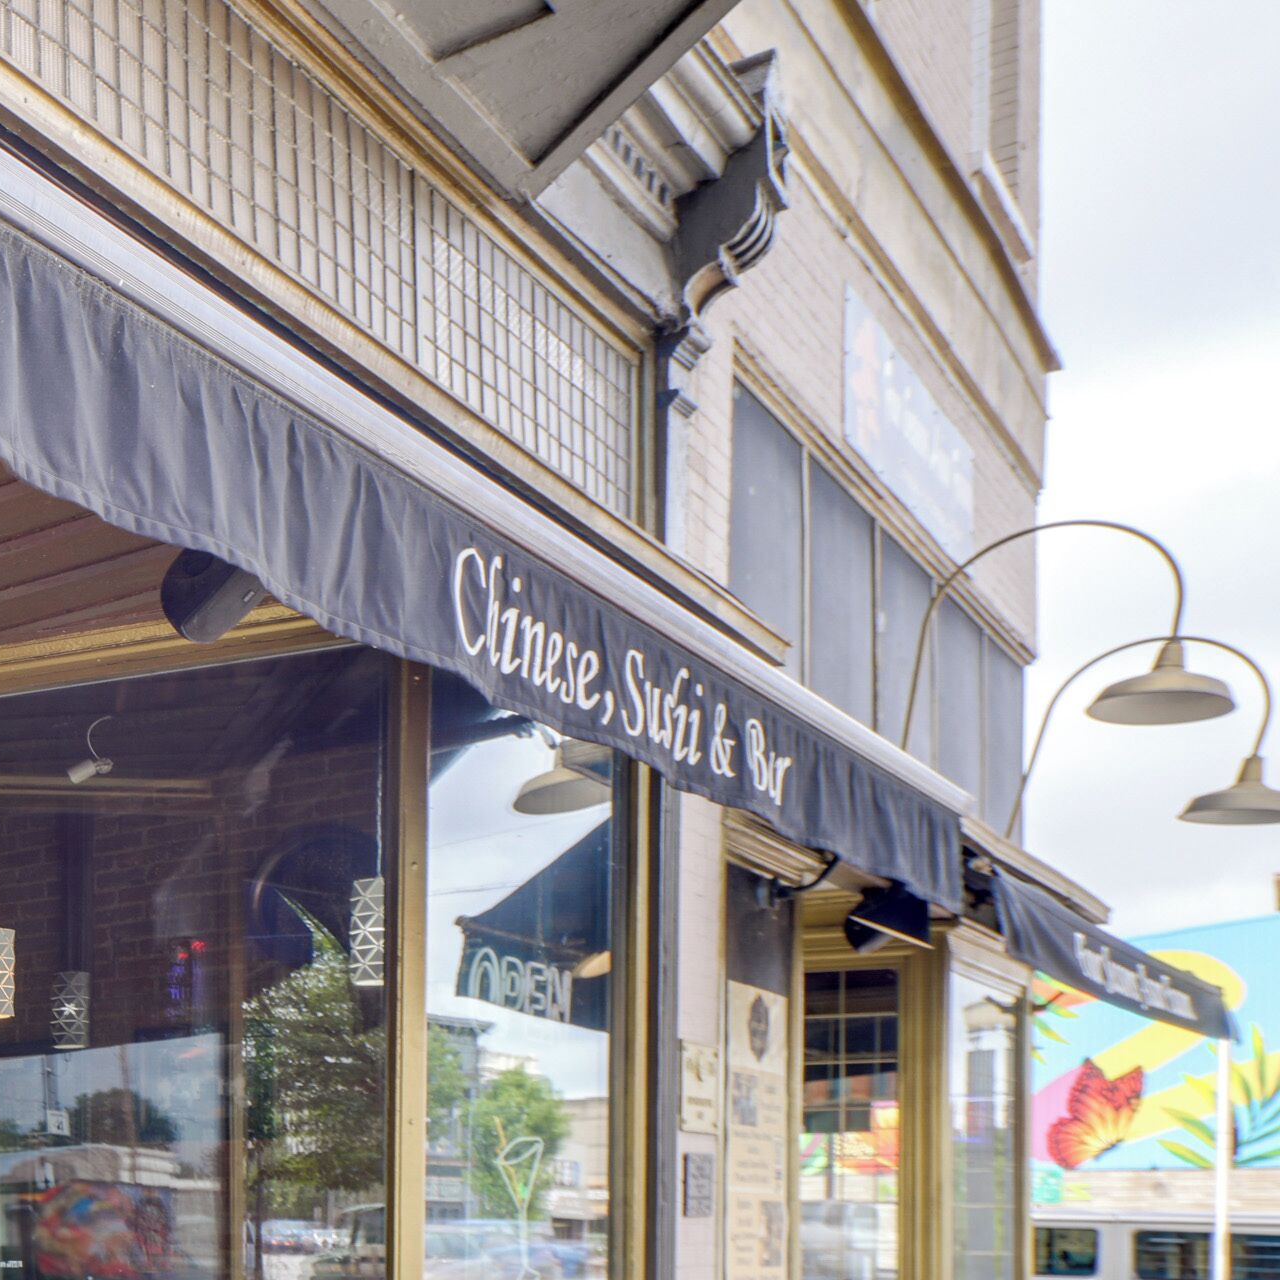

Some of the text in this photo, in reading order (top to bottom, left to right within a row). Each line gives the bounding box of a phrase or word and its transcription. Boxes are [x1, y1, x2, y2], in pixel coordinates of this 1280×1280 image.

[454, 547, 792, 806] Chinese, Sushi & Bar
[467, 946, 572, 1024] OPEN
